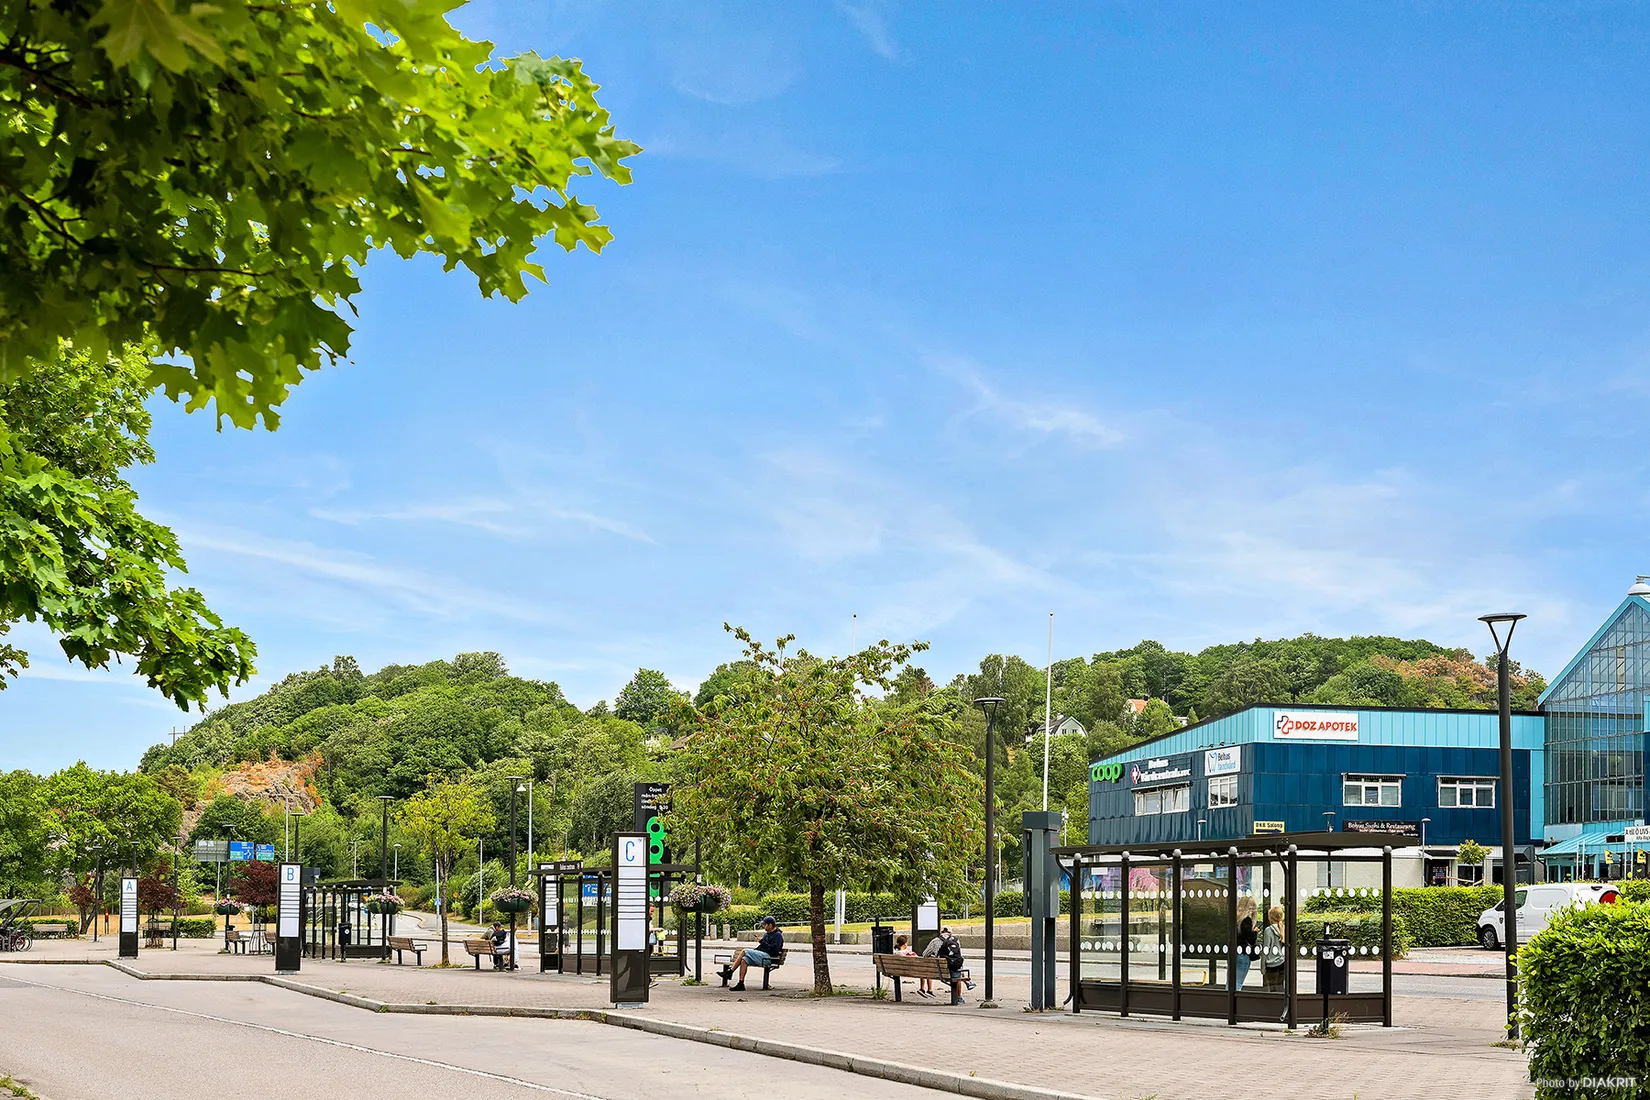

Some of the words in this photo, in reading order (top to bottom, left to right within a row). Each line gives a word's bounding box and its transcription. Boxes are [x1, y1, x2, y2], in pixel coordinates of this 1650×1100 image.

[1295, 721, 1317, 731] DOZ
[1318, 721, 1357, 732] APOTEK
[1092, 763, 1123, 784] coop
[625, 840, 635, 862] C
[287, 867, 295, 881] B
[126, 881, 133, 891] A
